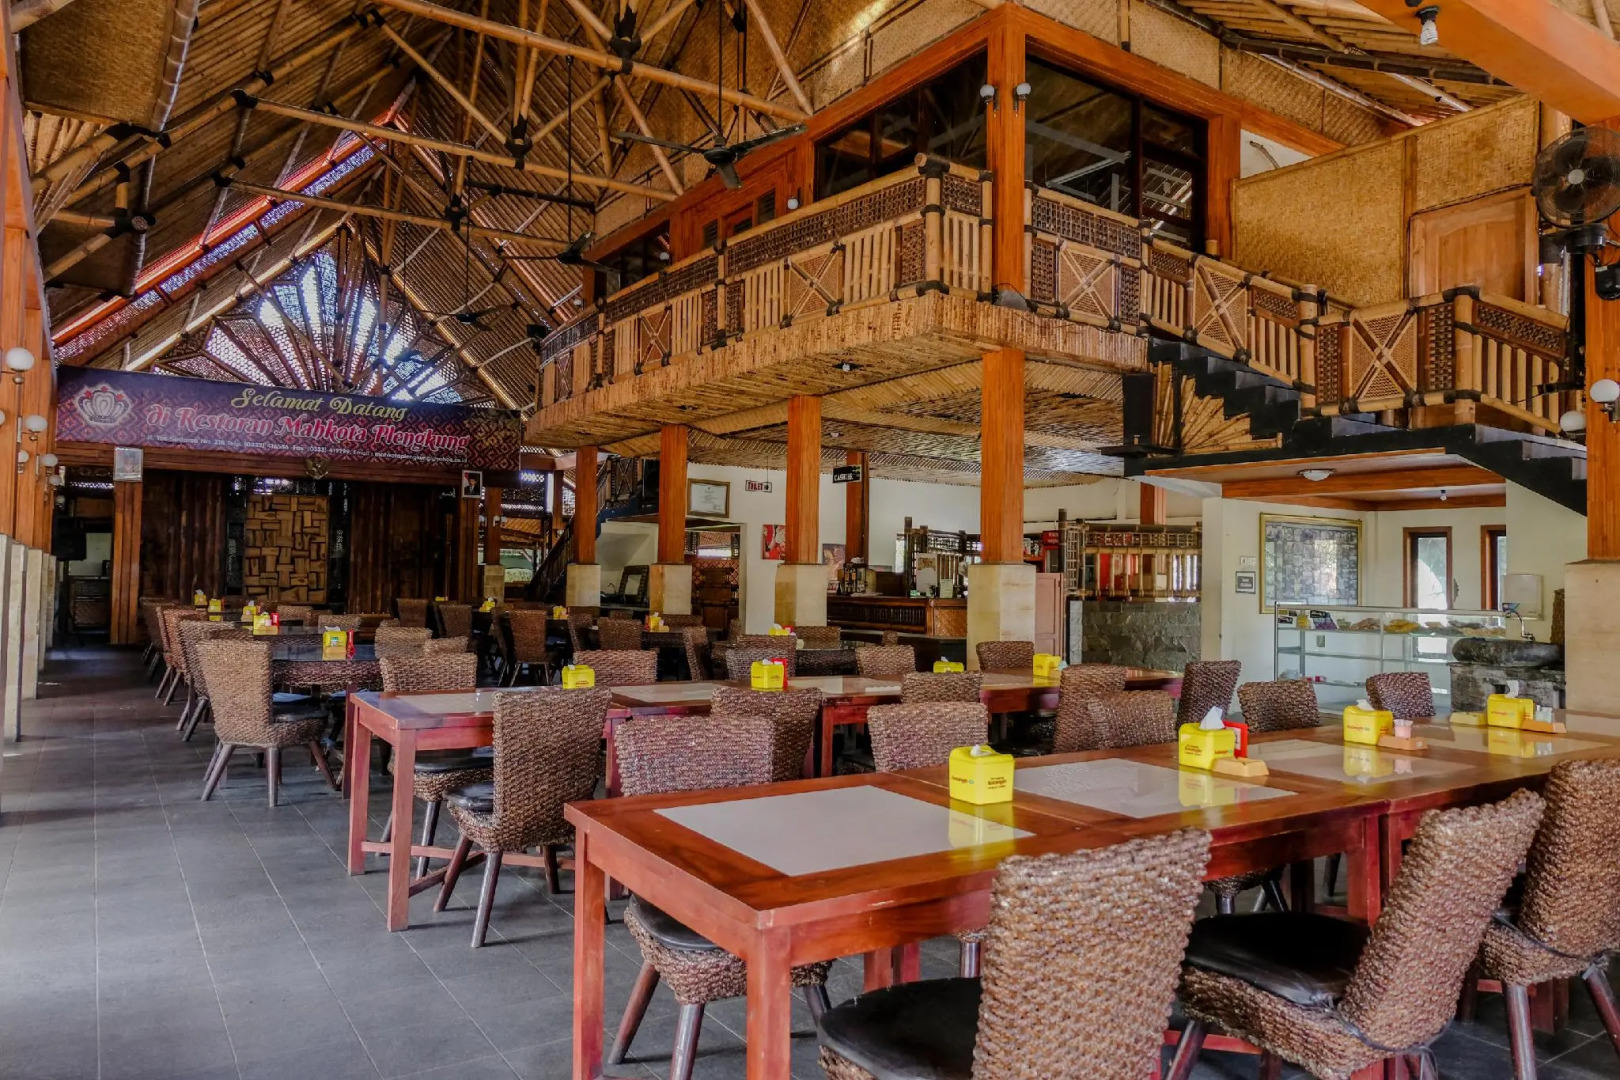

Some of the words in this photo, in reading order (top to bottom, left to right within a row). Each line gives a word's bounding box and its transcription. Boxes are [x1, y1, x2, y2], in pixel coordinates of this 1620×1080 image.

[230, 388, 324, 412] Selamat
[329, 397, 408, 421] Datang
[146, 404, 172, 426] di
[175, 407, 273, 435] Restoran
[274, 413, 368, 443] Mahkota
[372, 424, 471, 454] Plengkung
